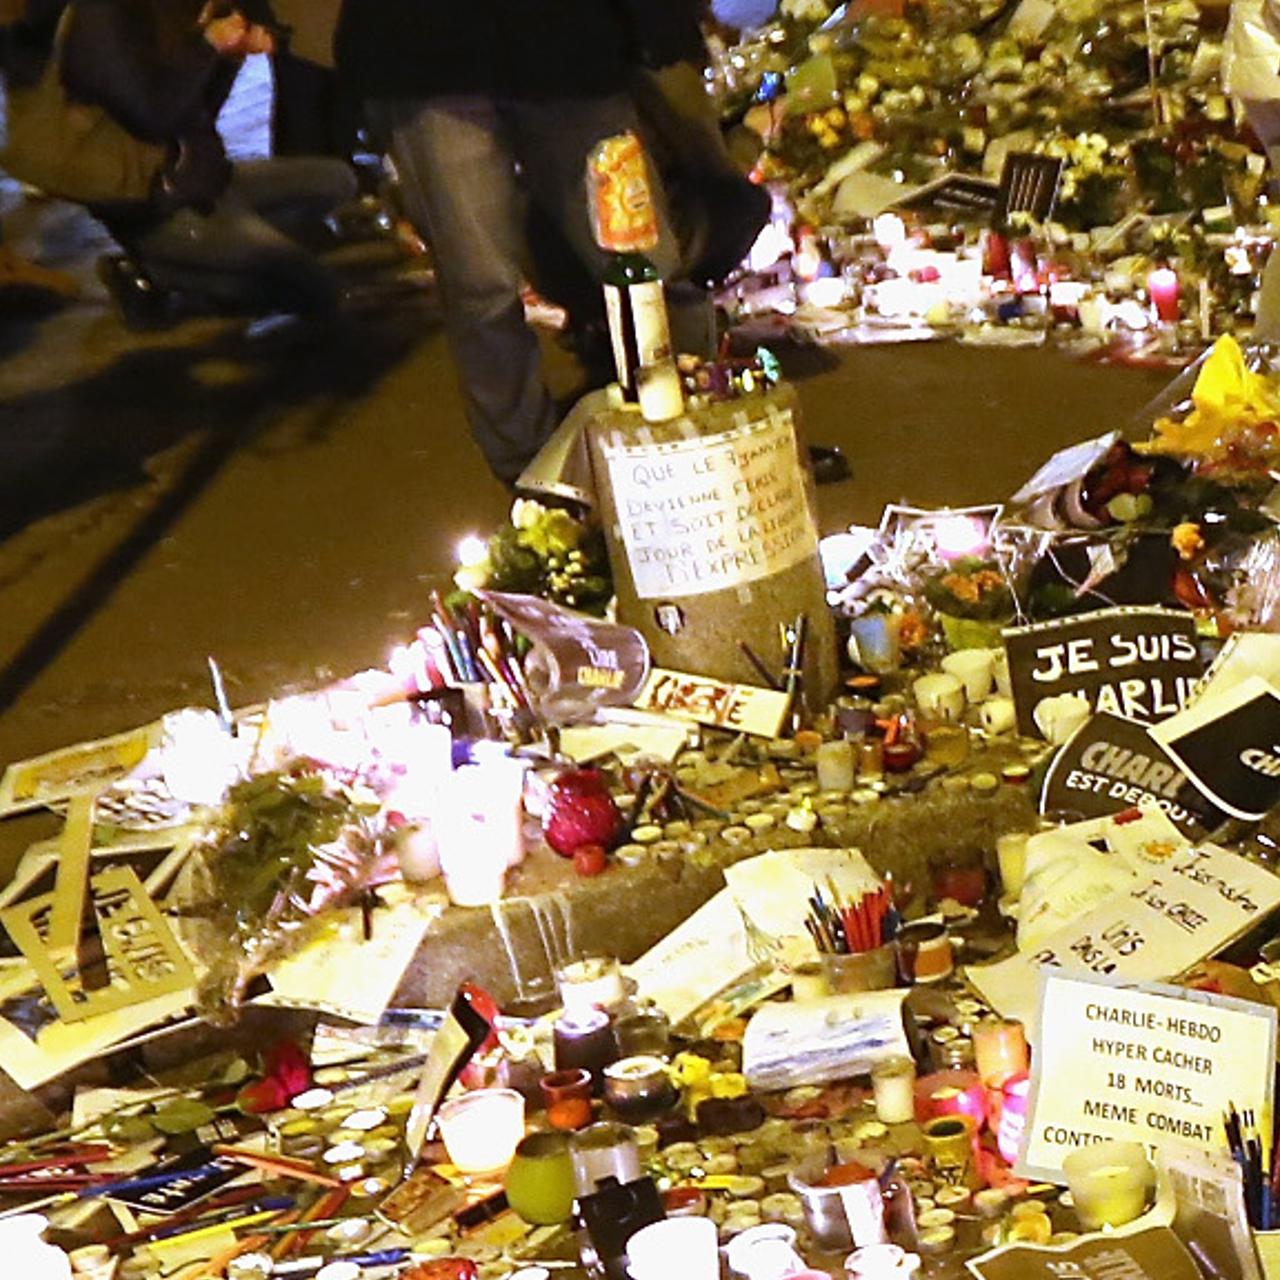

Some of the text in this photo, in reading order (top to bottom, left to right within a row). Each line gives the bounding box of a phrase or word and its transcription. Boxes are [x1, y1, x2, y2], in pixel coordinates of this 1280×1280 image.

[633, 464, 676, 487] QUE
[692, 458, 713, 474] LE
[631, 511, 725, 540] ET SOIT
[638, 543, 692, 564] JOUR
[707, 538, 725, 554] DE
[1033, 633, 1196, 683] JE SUIS
[1065, 770, 1109, 798] EST
[1167, 1017, 1221, 1044] HEBDO
[1092, 1037, 1213, 1075] HYPER CACHER
[1107, 1072, 1126, 1089] 18
[1083, 1100, 1214, 1142] MEME COMBAT
